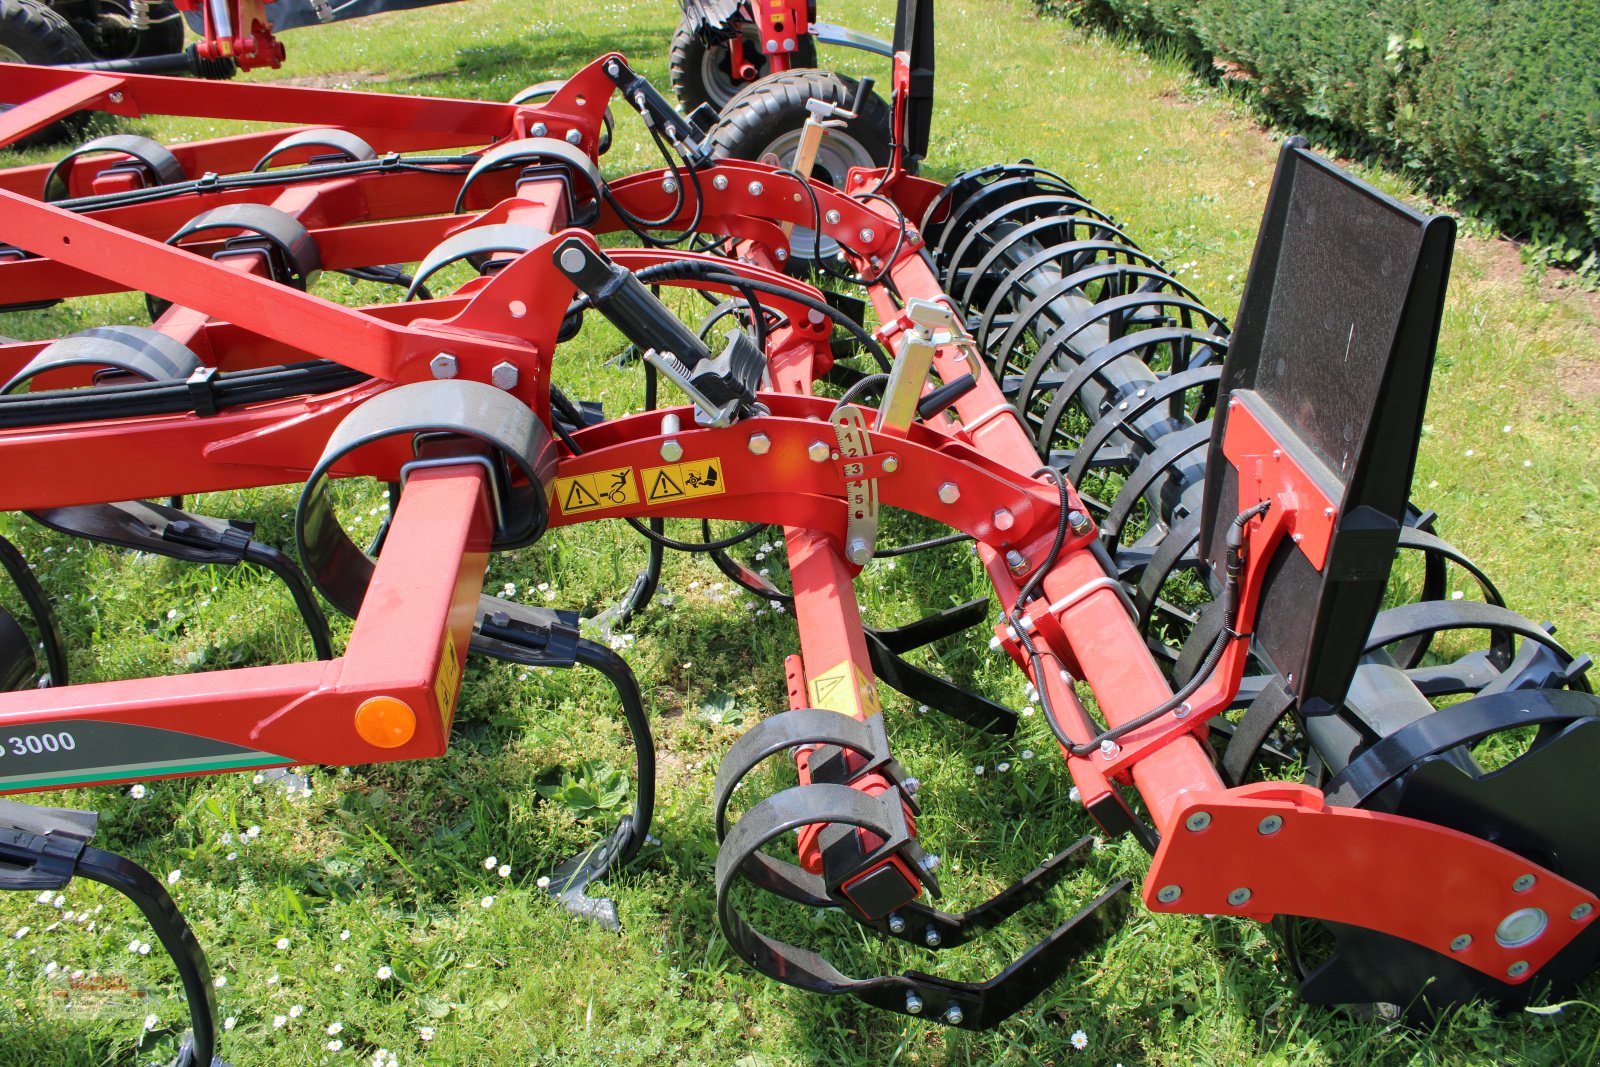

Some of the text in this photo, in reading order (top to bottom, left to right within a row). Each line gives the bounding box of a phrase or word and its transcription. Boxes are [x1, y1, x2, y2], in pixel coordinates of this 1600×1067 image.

[845, 432, 853, 442] 1
[848, 448, 858, 458] 2
[852, 463, 861, 474] 3
[853, 480, 863, 488] 4
[855, 494, 864, 505] 5
[855, 510, 864, 520] 6
[8, 732, 76, 755] 3000
